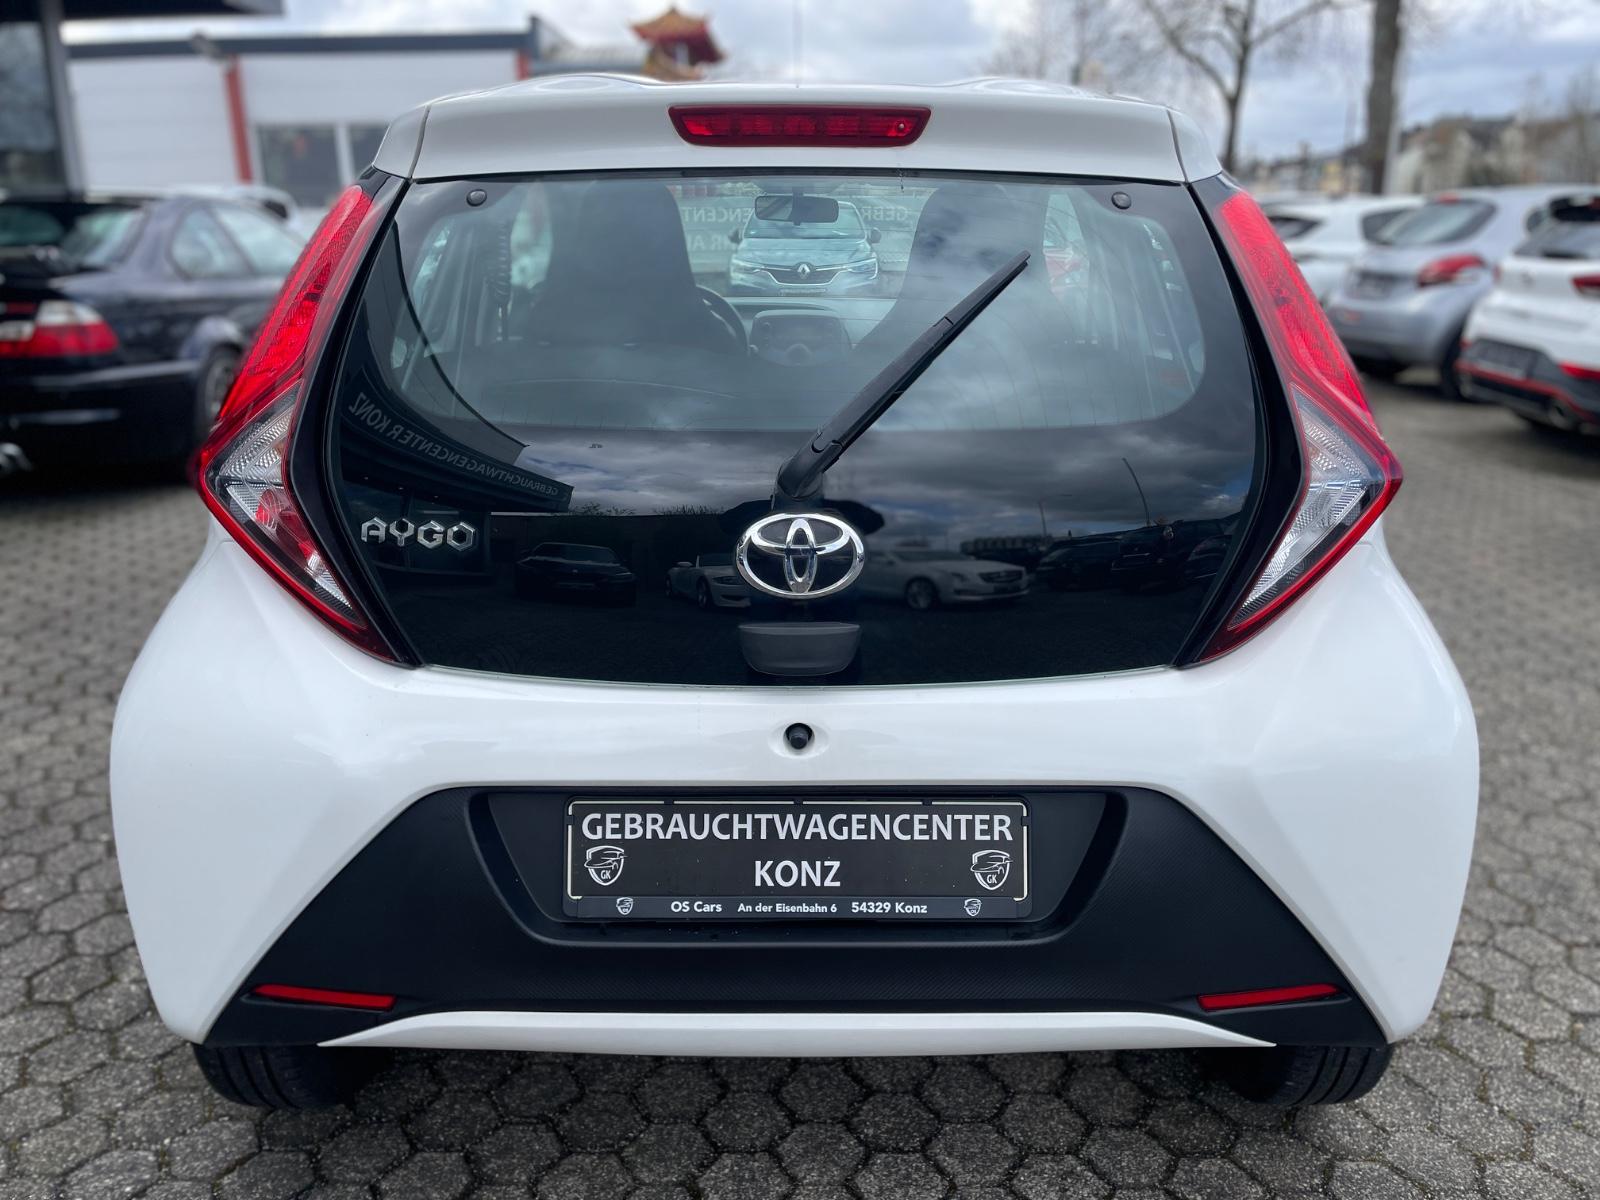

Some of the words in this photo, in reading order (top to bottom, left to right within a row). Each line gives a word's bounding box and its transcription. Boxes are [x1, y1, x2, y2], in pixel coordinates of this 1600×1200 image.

[361, 516, 476, 551] AYGO
[581, 812, 1013, 841] GEBRAUCHTWAGENCENTER
[600, 869, 611, 880] GK
[754, 860, 841, 888] KONZ
[986, 874, 997, 884] GK
[670, 901, 690, 913] OS
[693, 901, 723, 913] Cars
[737, 902, 753, 913] An
[755, 902, 773, 913] der
[775, 902, 828, 913] Eisenbahn
[830, 903, 838, 913] 6
[851, 902, 891, 914] 54329
[895, 902, 928, 914] Konz
